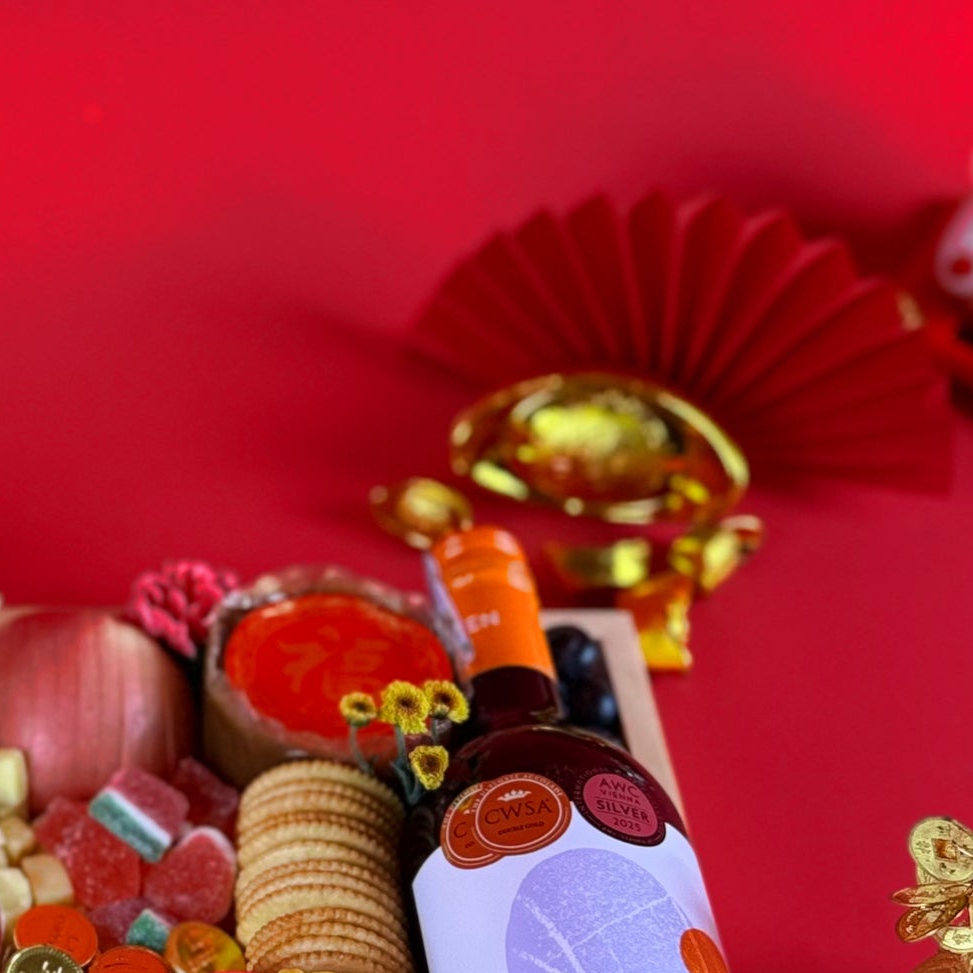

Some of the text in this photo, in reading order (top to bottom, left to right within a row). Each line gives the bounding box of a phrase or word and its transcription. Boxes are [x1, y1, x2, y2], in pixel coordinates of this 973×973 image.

[599, 778, 639, 798] AWC
[600, 789, 641, 805] VIENNA
[484, 801, 552, 825] CWSA
[597, 799, 649, 823] SILVER
[614, 817, 642, 832] 2025
